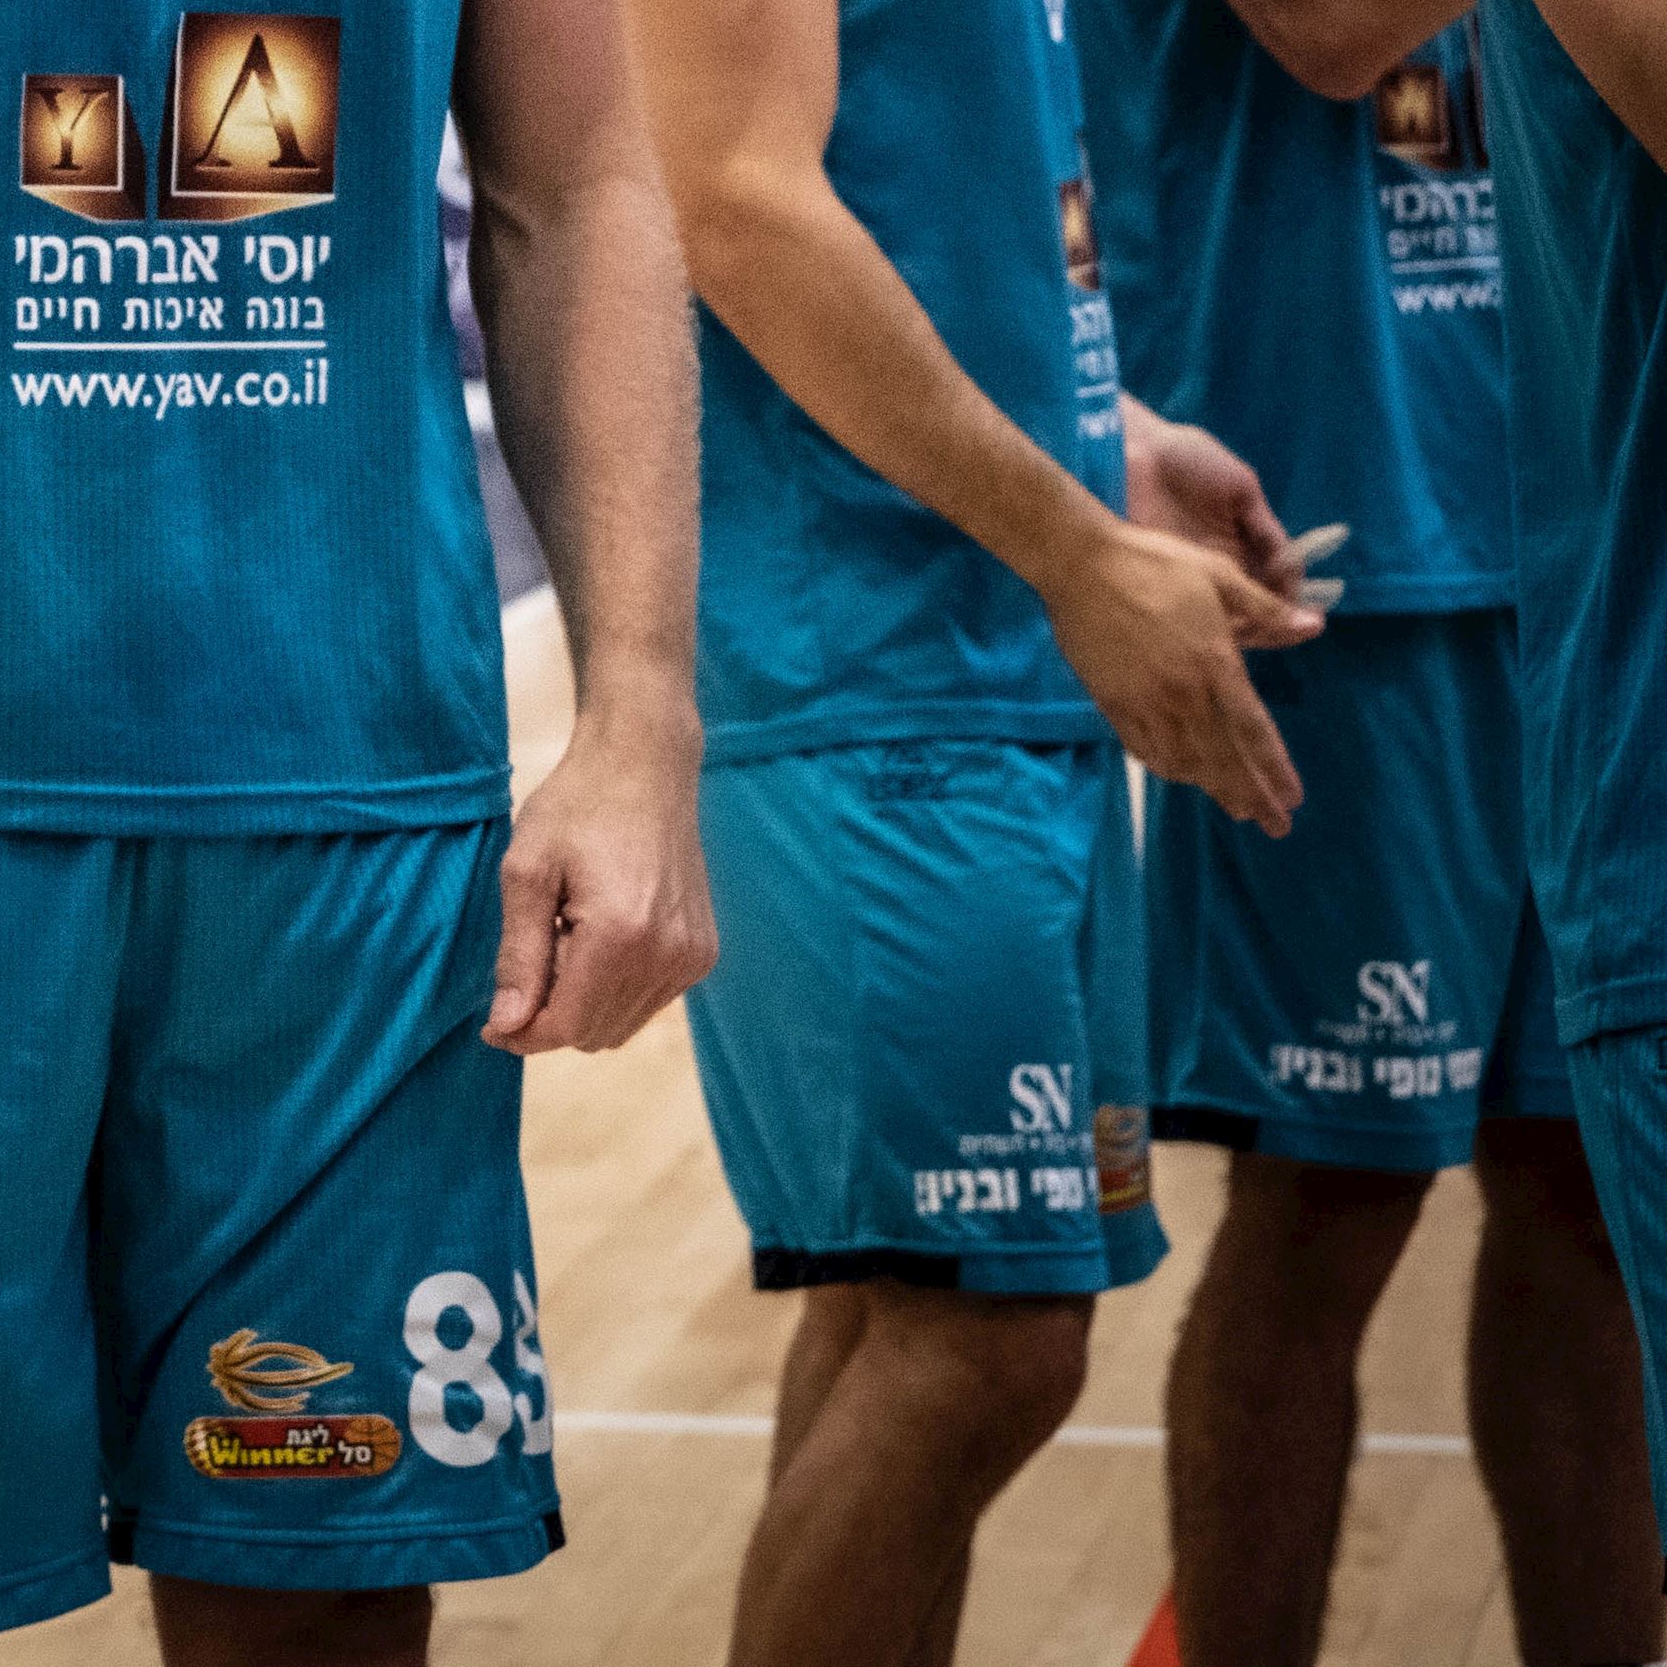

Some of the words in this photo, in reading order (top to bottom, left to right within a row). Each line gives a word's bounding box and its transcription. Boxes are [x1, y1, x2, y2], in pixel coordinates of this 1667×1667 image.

[14, 234, 219, 284] אברהמי
[243, 234, 332, 284] יוסי
[16, 296, 101, 331] חיים
[122, 296, 224, 331] איכות
[245, 296, 325, 331] בונה
[11, 357, 328, 421] www.yav.co.il
[208, 1435, 335, 1468] Winner
[338, 1444, 372, 1464] סל
